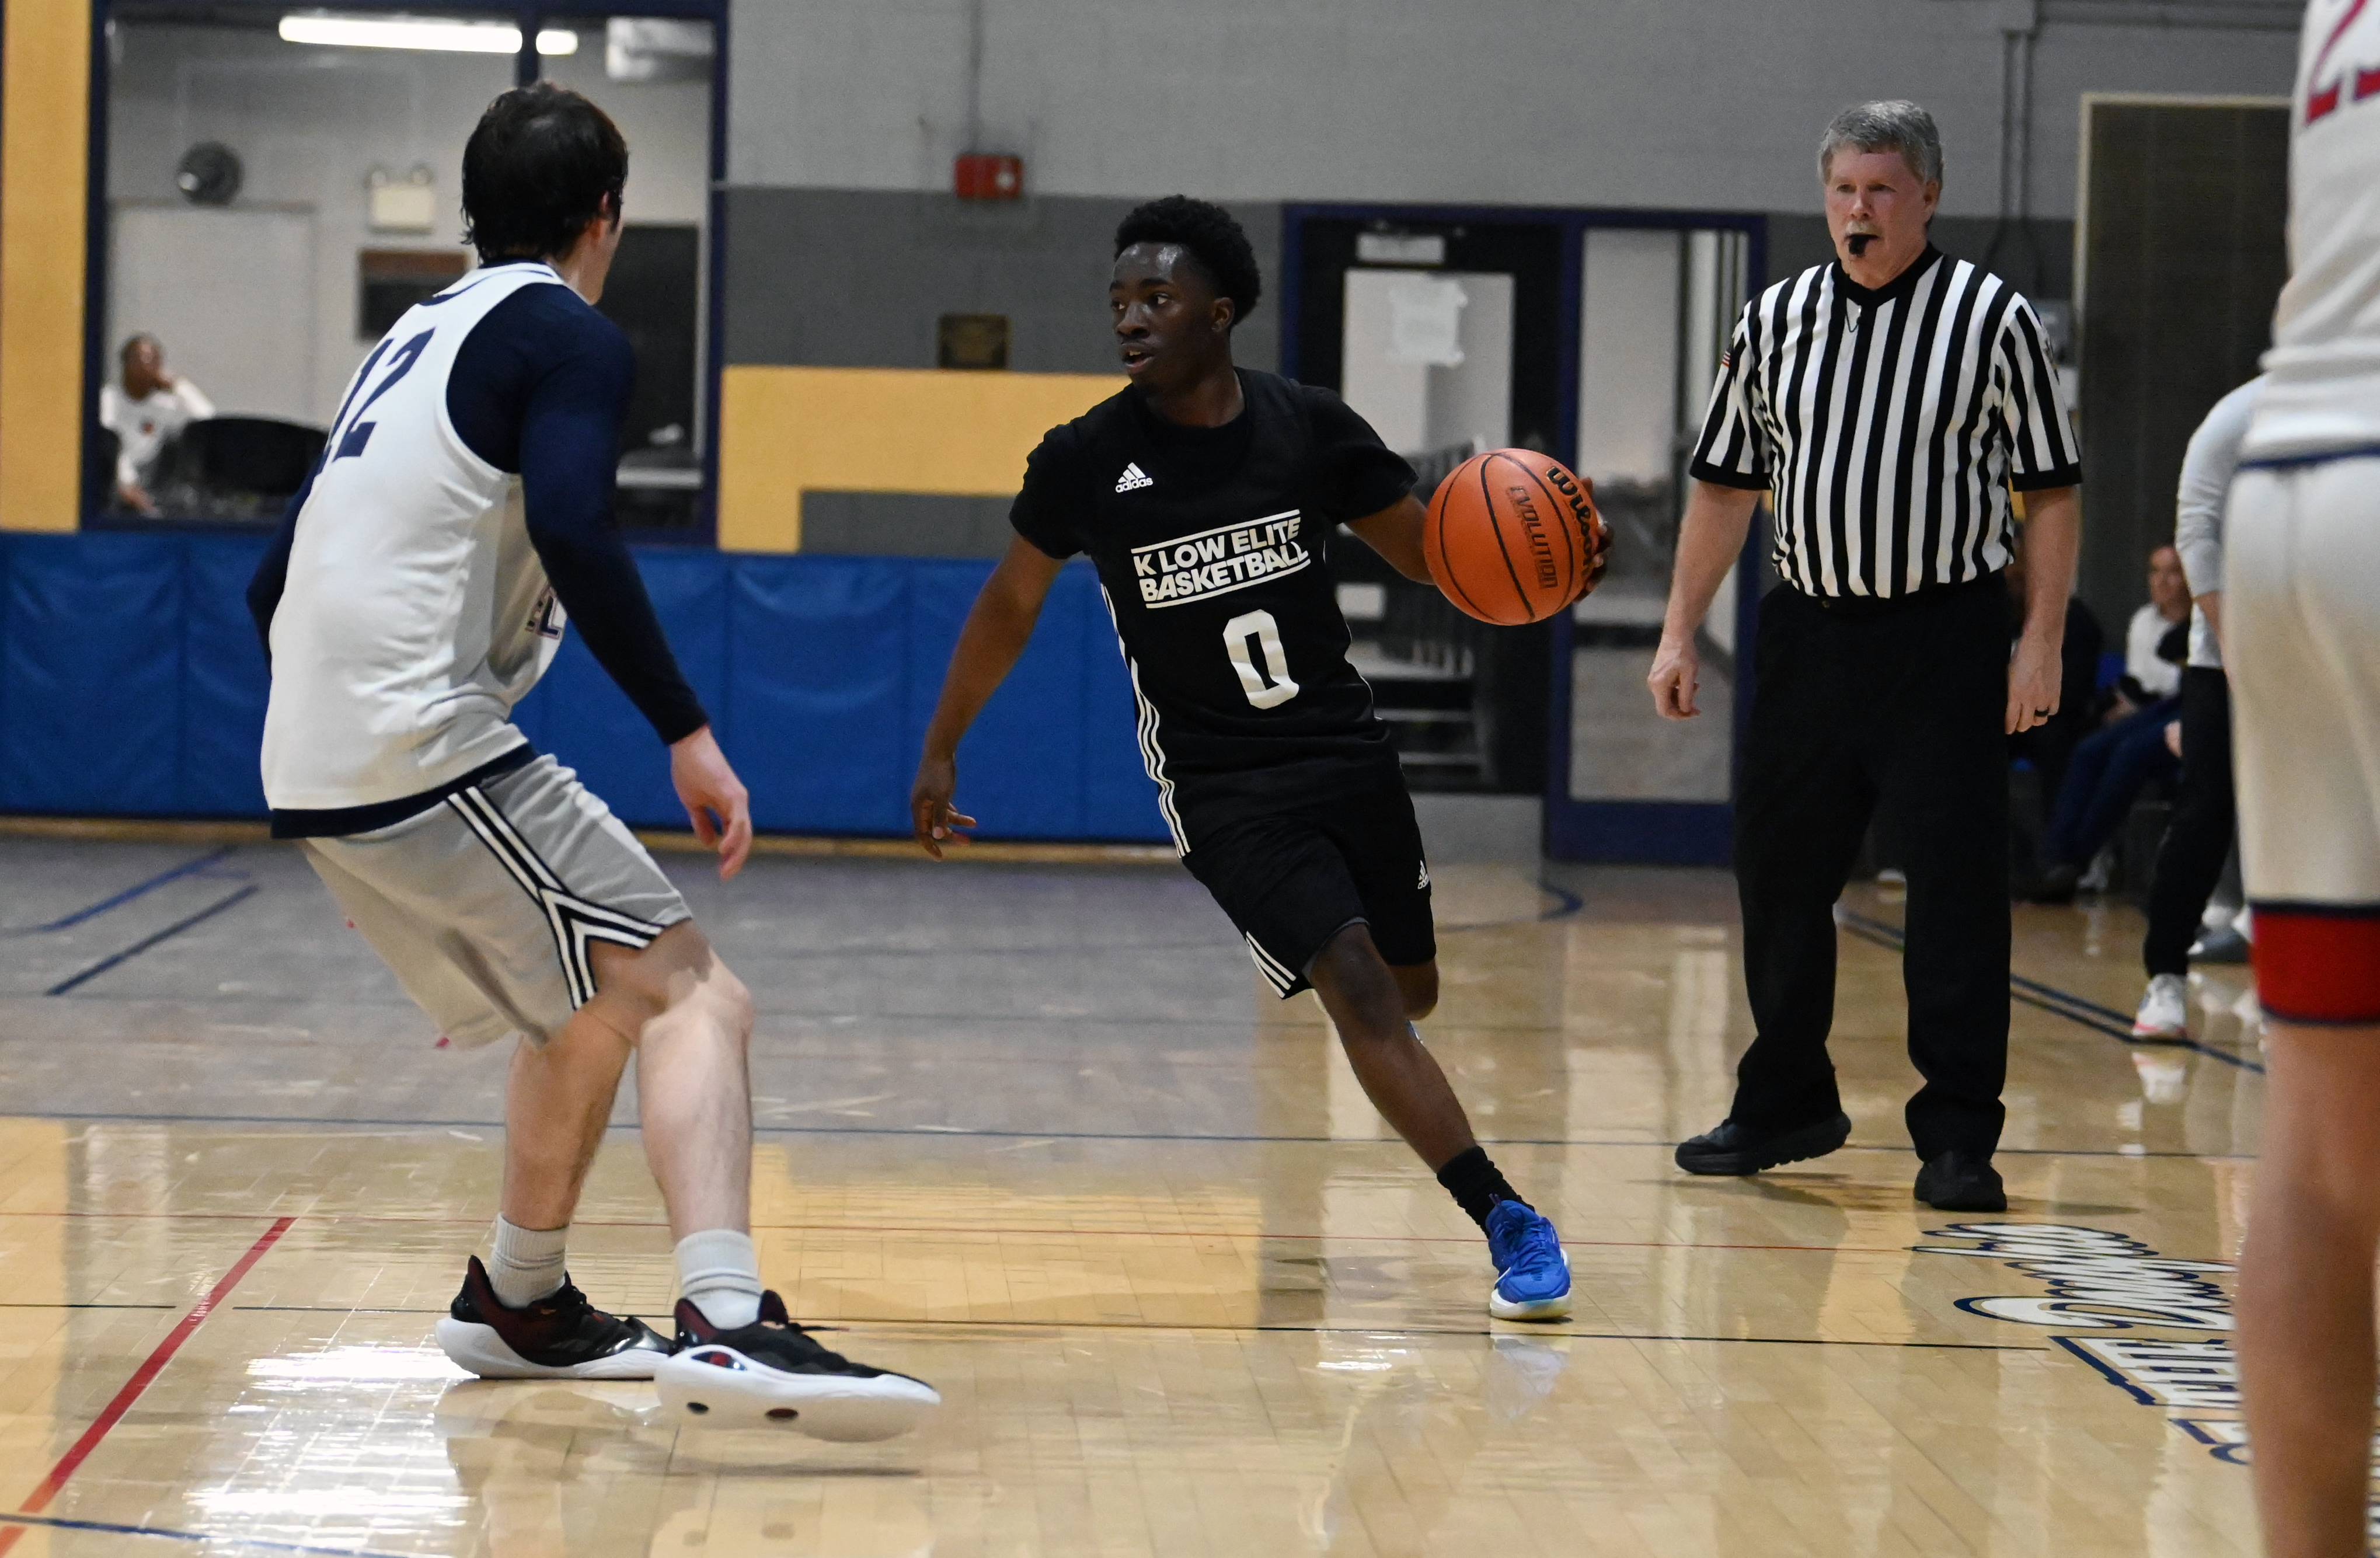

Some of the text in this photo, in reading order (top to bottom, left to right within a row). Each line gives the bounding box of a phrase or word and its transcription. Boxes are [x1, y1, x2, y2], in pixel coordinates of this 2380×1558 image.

[322, 326, 437, 468] 12
[1116, 477, 1153, 493] adidas
[1133, 517, 1301, 577] K LOW ELITE
[1140, 541, 1309, 602] BASKETBALL
[1507, 486, 1558, 588] EVOLUTION
[1222, 609, 1300, 710] 0
